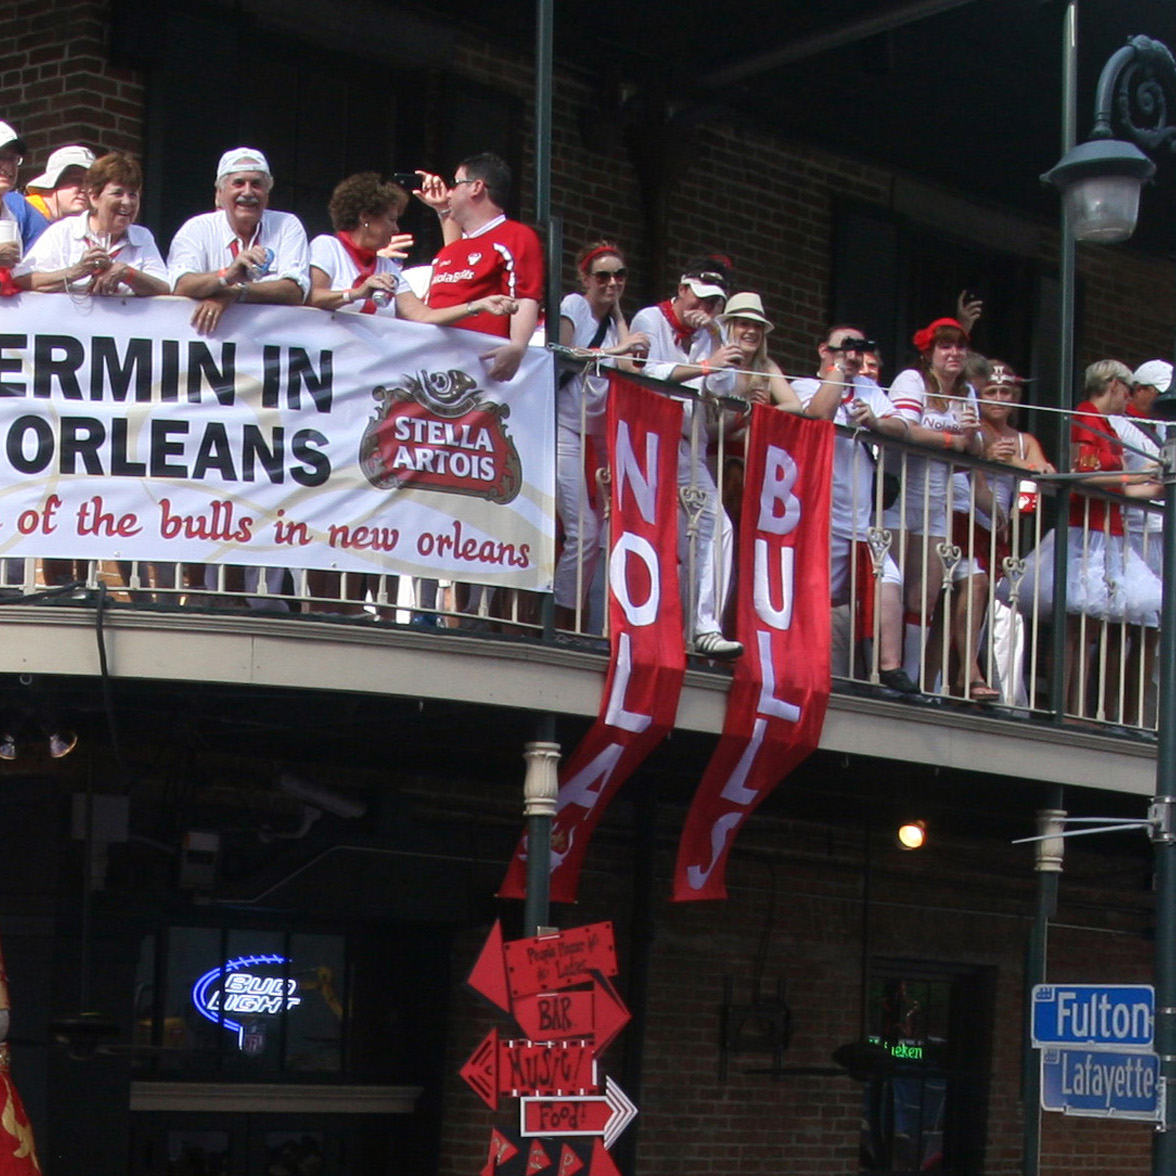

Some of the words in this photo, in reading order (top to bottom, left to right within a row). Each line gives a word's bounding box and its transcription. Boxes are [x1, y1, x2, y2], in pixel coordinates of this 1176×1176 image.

[262, 345, 333, 413] IN
[6, 415, 331, 487] ORLEANS
[392, 446, 495, 481] ARTOIS
[394, 416, 494, 452] STELLA
[16, 494, 63, 535] of
[77, 495, 142, 537] the
[158, 498, 253, 541] bulls
[273, 509, 313, 546] in
[328, 523, 399, 551] new
[417, 520, 531, 568] orleans
[555, 419, 659, 821] NOLA
[687, 445, 801, 891] BULLS
[538, 997, 572, 1031] BAR
[1057, 992, 1149, 1038] Fulton
[1062, 1053, 1153, 1107] Lafayette
